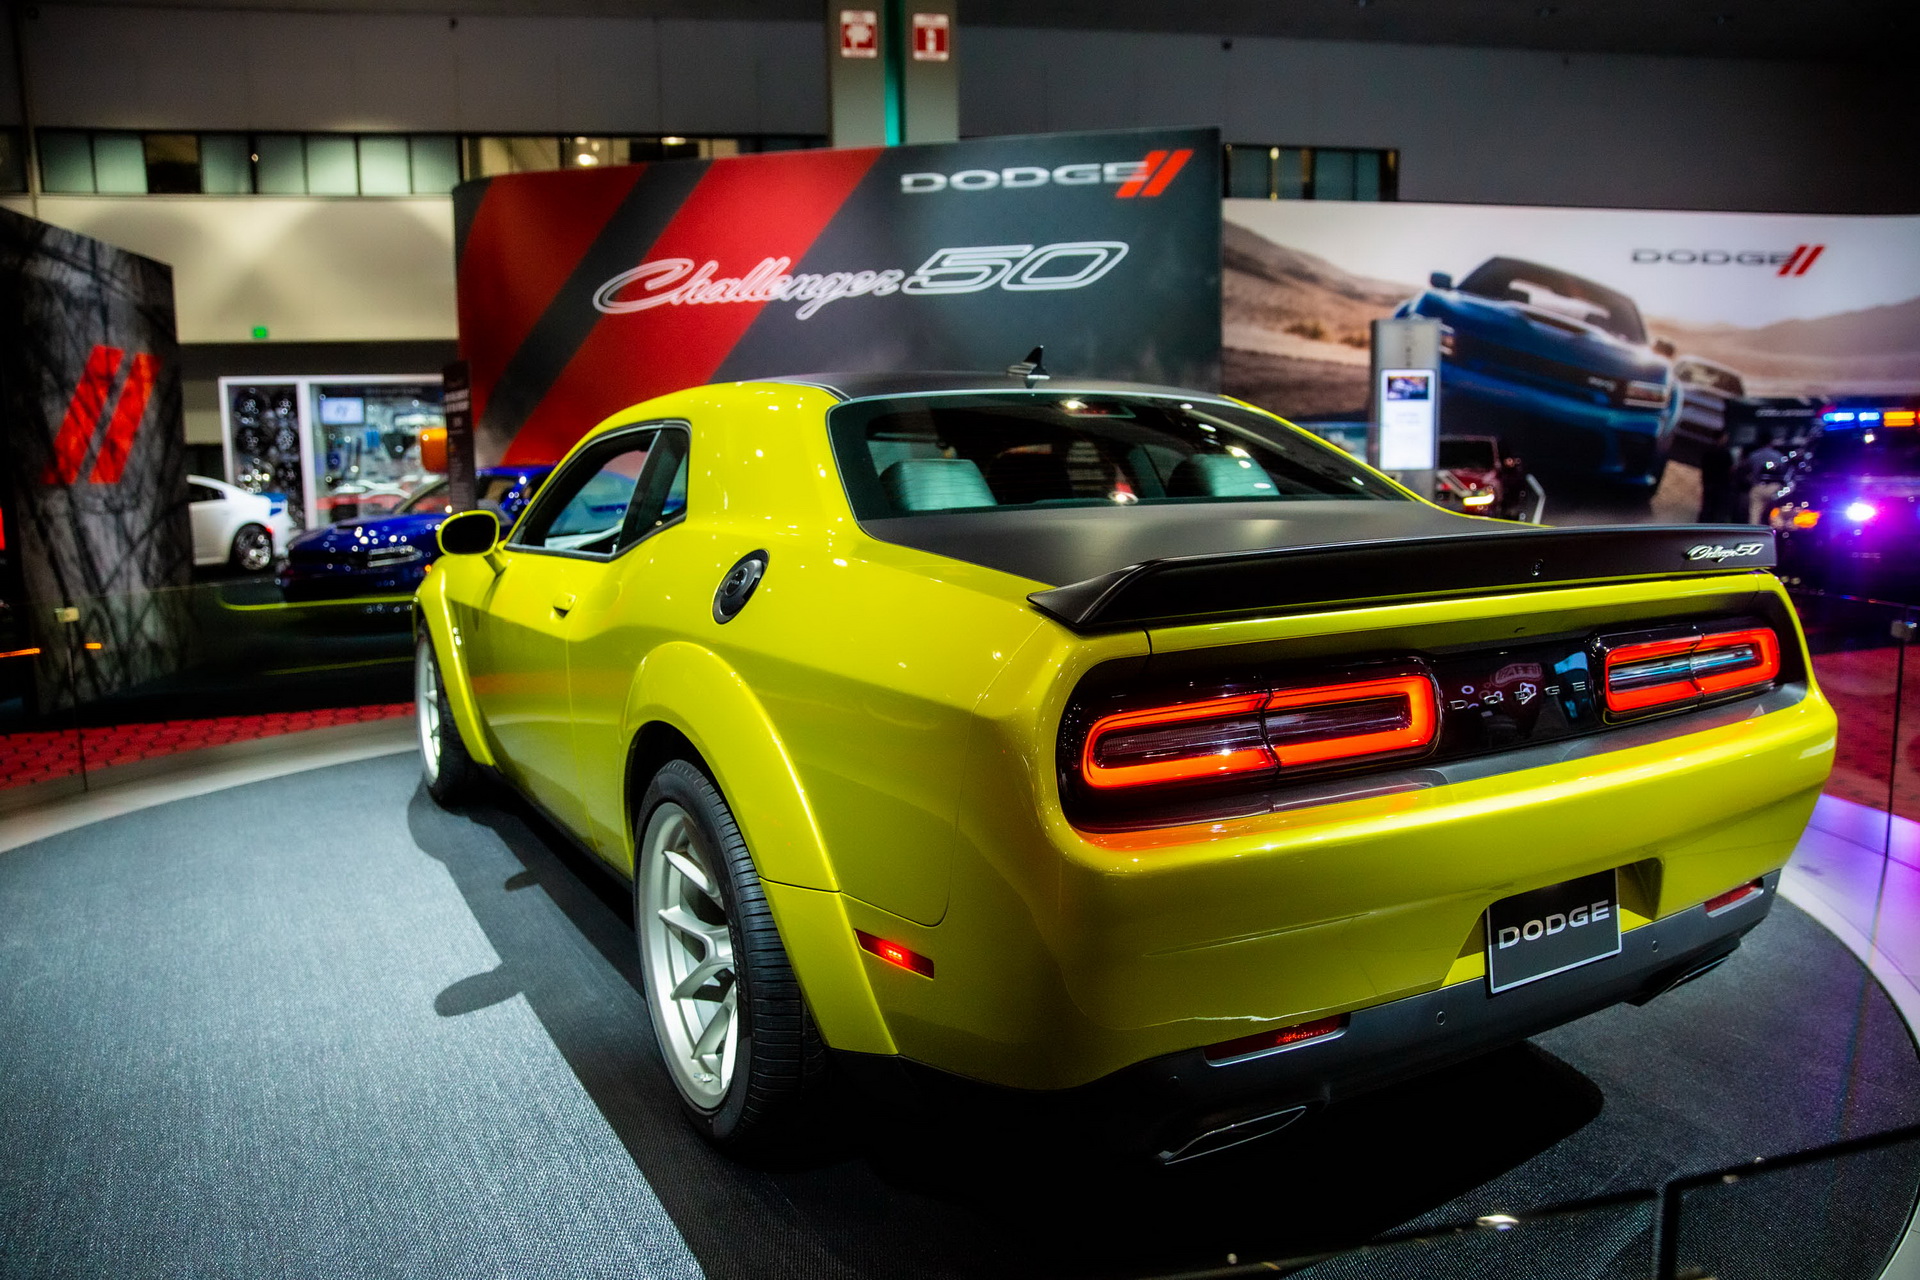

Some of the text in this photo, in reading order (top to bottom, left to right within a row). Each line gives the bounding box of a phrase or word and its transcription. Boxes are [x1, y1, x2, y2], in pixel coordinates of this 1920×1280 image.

[900, 160, 1149, 194] DODGE
[1632, 248, 1798, 267] DODGE
[592, 241, 1130, 321] Challenger 50
[1498, 899, 1611, 950] DODGE
